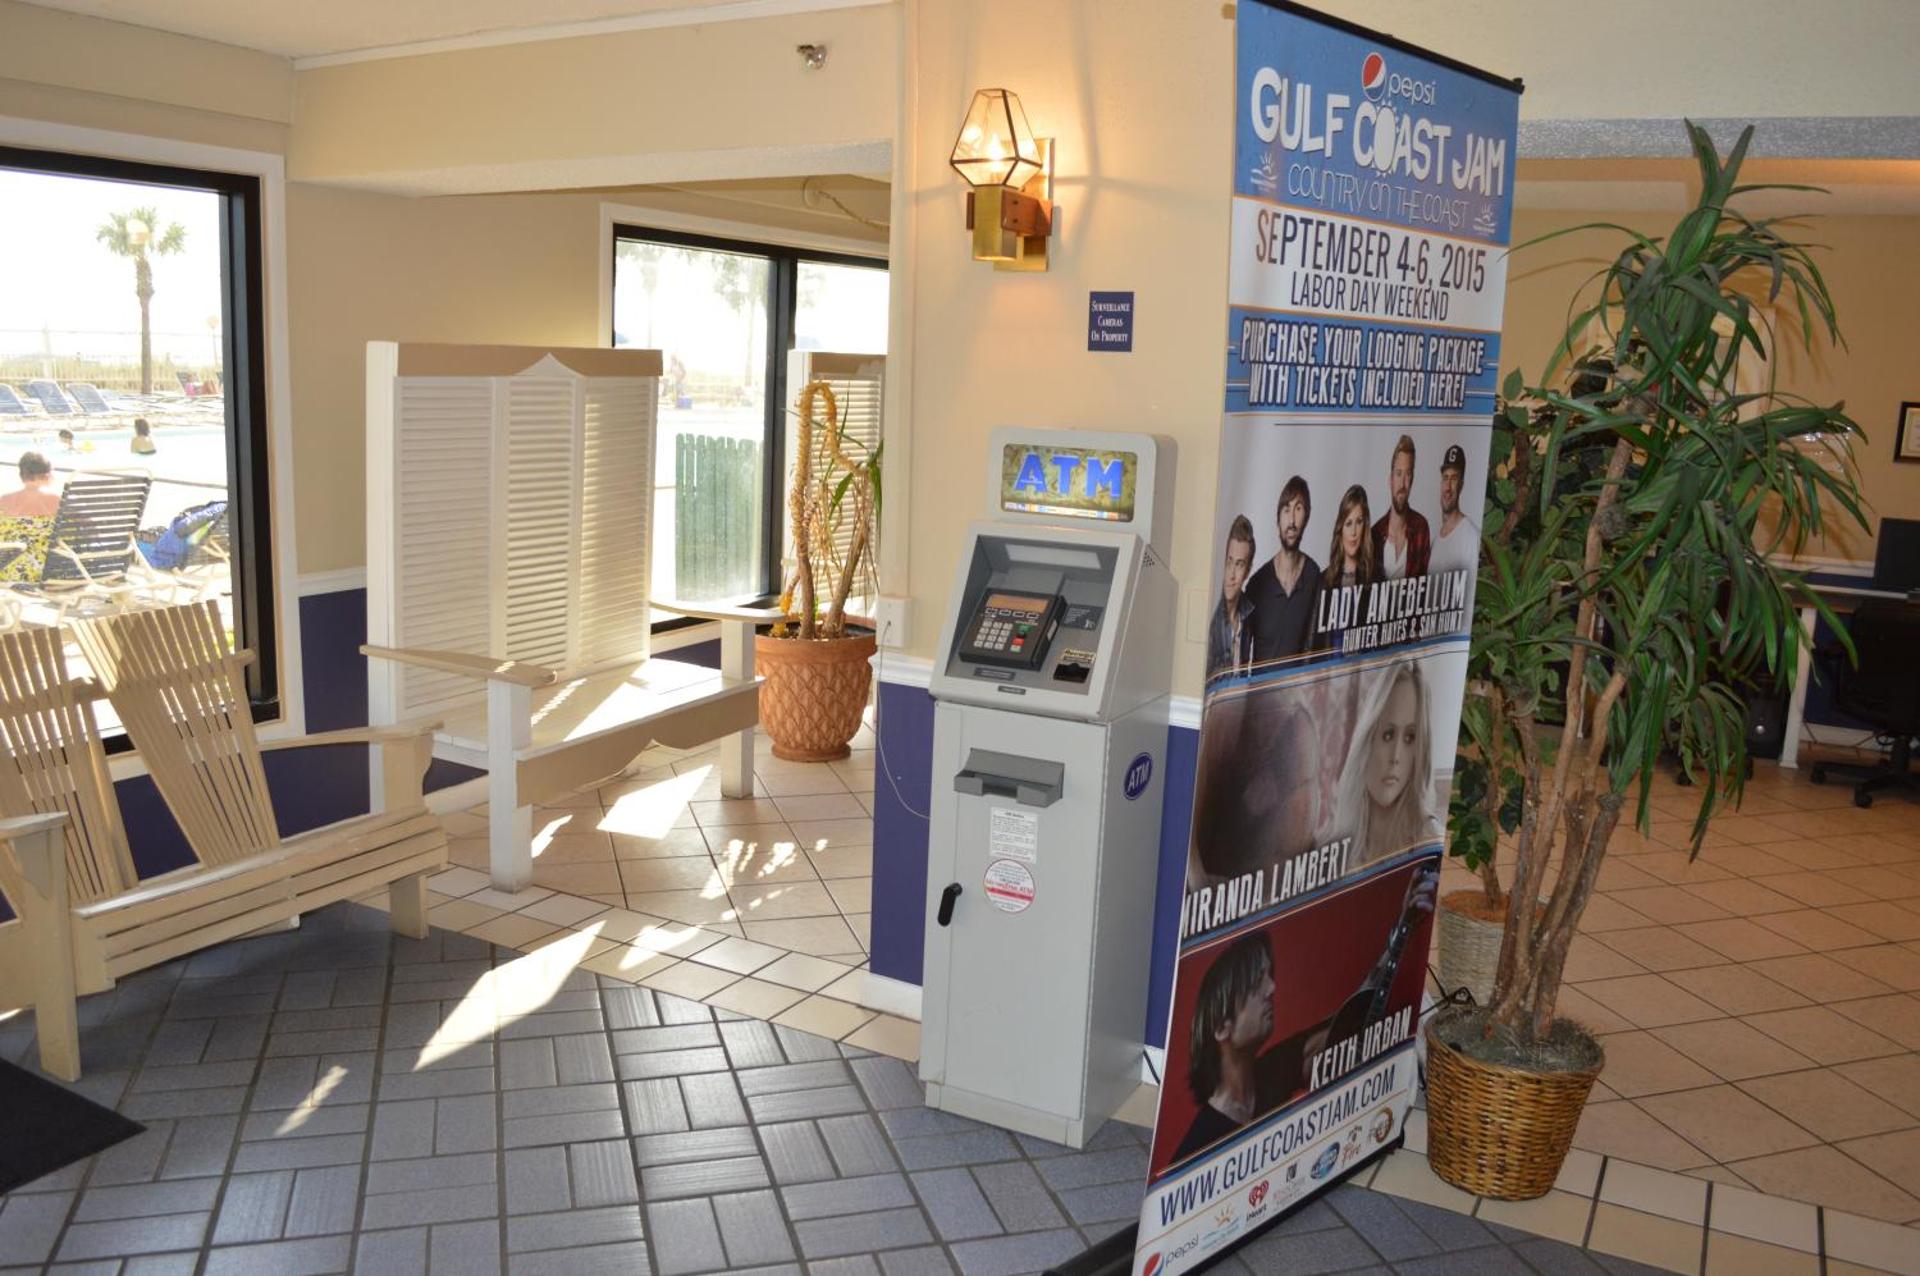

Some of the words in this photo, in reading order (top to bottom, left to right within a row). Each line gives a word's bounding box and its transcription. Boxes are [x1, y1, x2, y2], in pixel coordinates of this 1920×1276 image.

[1388, 73, 1436, 105] pepsi
[1251, 67, 1350, 158] GULF
[1353, 101, 1451, 184] COAST
[1452, 133, 1506, 196] JAM
[1395, 186, 1422, 224] THE
[1422, 193, 1469, 229] COAST
[1256, 209, 1391, 279] SEPTEMBER
[1397, 236, 1433, 291] 4-6,
[1440, 244, 1486, 293] 2015
[1291, 272, 1346, 309] LABOR
[1351, 279, 1380, 314] DAY
[1384, 284, 1449, 321] WEEKEND
[1241, 319, 1318, 364] PURCHASE
[1324, 327, 1362, 368] YOUR
[1366, 330, 1424, 371] LODGING
[1426, 336, 1484, 375] PACKAGE
[1250, 363, 1289, 405] WITH
[1295, 365, 1356, 406] TICKETS
[1360, 368, 1425, 407] INCLUDED
[1427, 374, 1466, 409] HERE!
[1014, 453, 1123, 500] ATM
[1317, 584, 1363, 634] LADY
[1366, 570, 1468, 624] ANTEBELLUM
[1342, 625, 1378, 654] HUNTER
[1380, 618, 1407, 646] HAYES
[1409, 617, 1418, 639] &
[1419, 613, 1437, 637] SAM
[1437, 610, 1465, 635] HUNT
[1127, 760, 1150, 791] ATM
[1270, 837, 1351, 904] LAMBERT
[1310, 1033, 1358, 1092] KEITH
[1361, 1005, 1412, 1062] URBAN
[1160, 1064, 1395, 1227] WWW.GULFCOASTJAM.COM
[1165, 1232, 1199, 1267] pepsi
